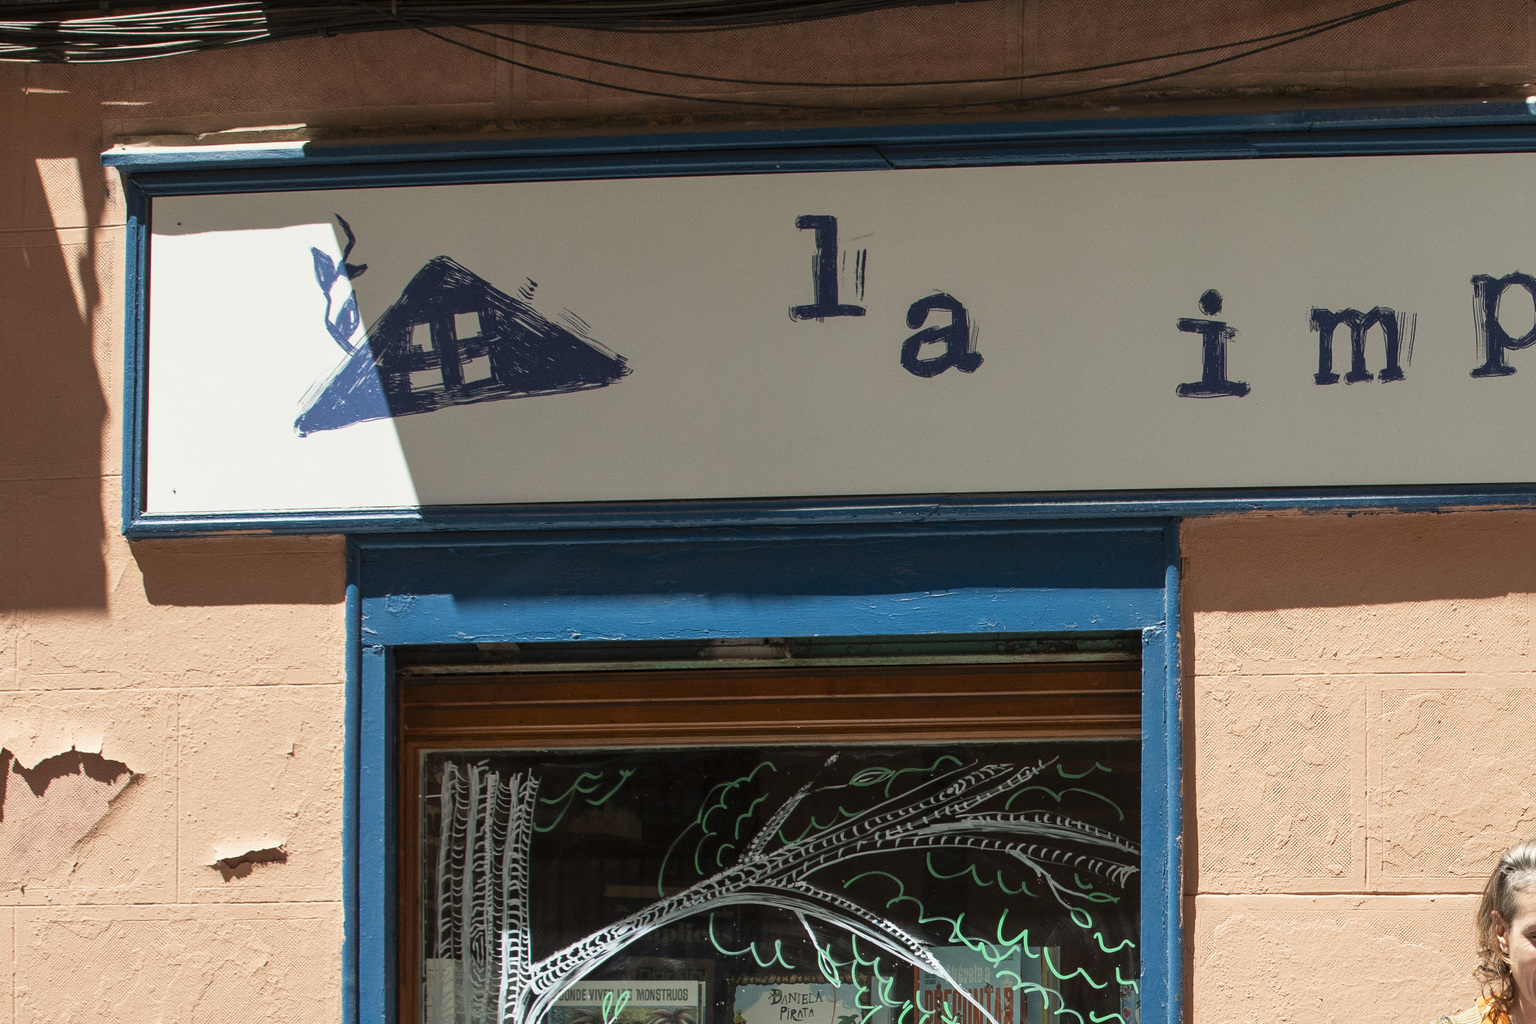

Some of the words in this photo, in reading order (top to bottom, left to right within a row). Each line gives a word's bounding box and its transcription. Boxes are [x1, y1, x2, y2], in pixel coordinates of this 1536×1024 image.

[788, 214, 985, 379] la
[636, 988, 689, 1001] MONSTRUOS
[769, 988, 824, 1005] DANIELA
